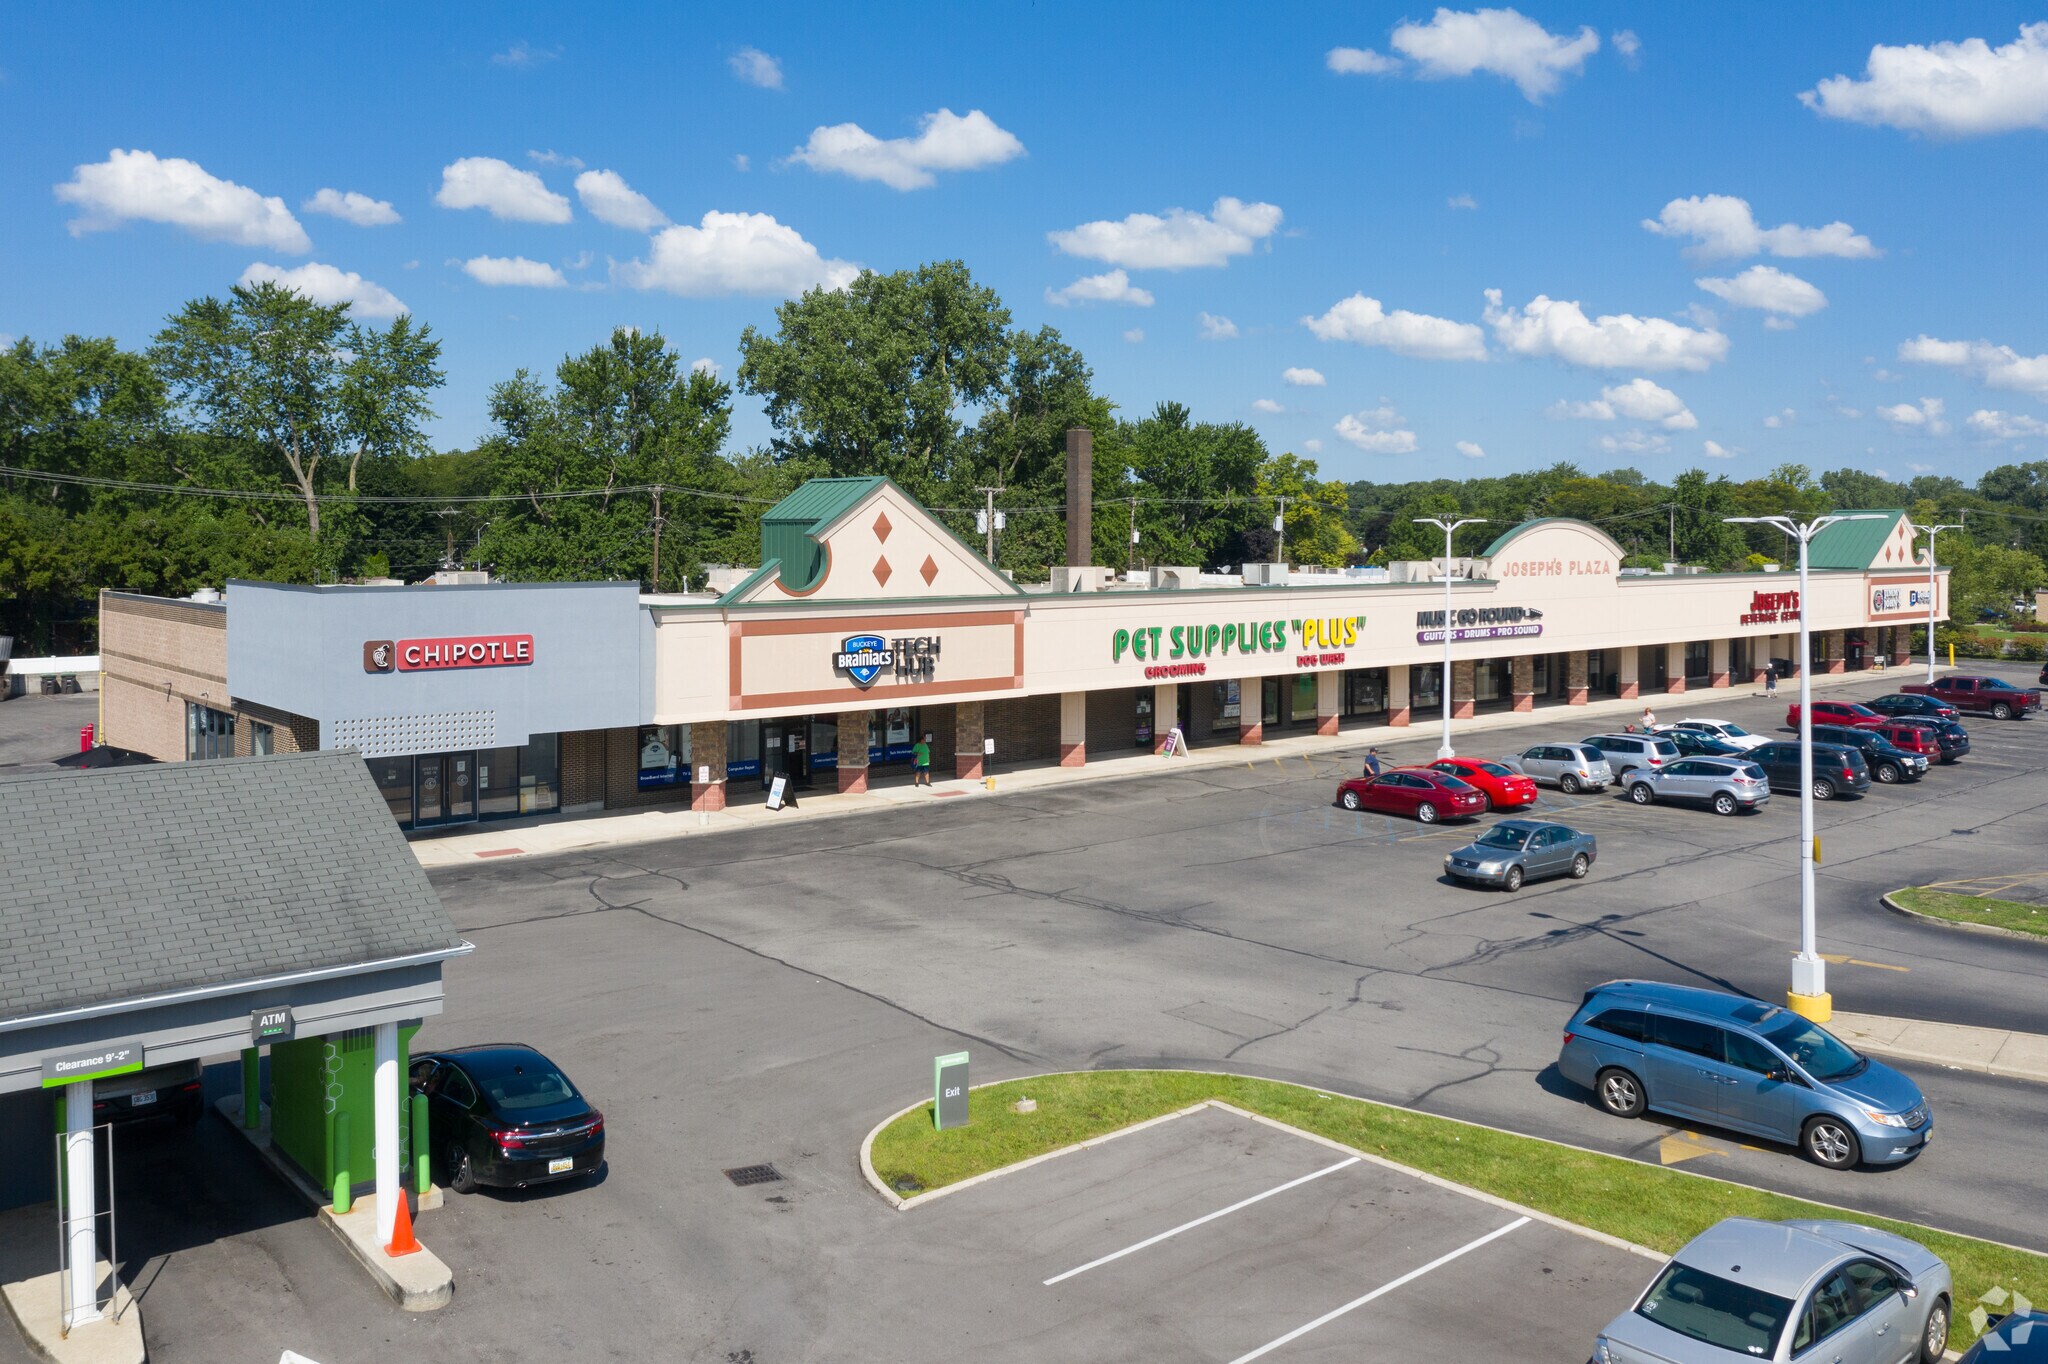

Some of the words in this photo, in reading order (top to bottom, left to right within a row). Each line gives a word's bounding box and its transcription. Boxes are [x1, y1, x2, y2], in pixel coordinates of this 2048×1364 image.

[1503, 558, 1562, 577] JOSEPH'S
[1569, 560, 1611, 575] PLAZA
[1417, 609, 1457, 627] MUSC
[1457, 607, 1478, 625] GO
[1479, 606, 1523, 624] ROUND
[1113, 626, 1163, 660] PET
[1170, 619, 1287, 658] SUPPLIES
[1292, 616, 1367, 647] "PLUS"
[1464, 628, 1490, 639] DRUMS
[1497, 627, 1512, 636] PRO
[1514, 625, 1539, 635] SOUND
[405, 641, 529, 664] CHIPOTLE
[852, 640, 878, 648] BUCKEYE
[891, 636, 941, 658] TECH
[896, 656, 935, 678] HUB
[1297, 655, 1318, 667] DOG
[1320, 653, 1345, 665] WASH
[1145, 662, 1206, 679] GROOMING
[260, 1012, 286, 1026] ATM
[55, 1056, 103, 1072] Clearance
[945, 1086, 960, 1098] Exit
